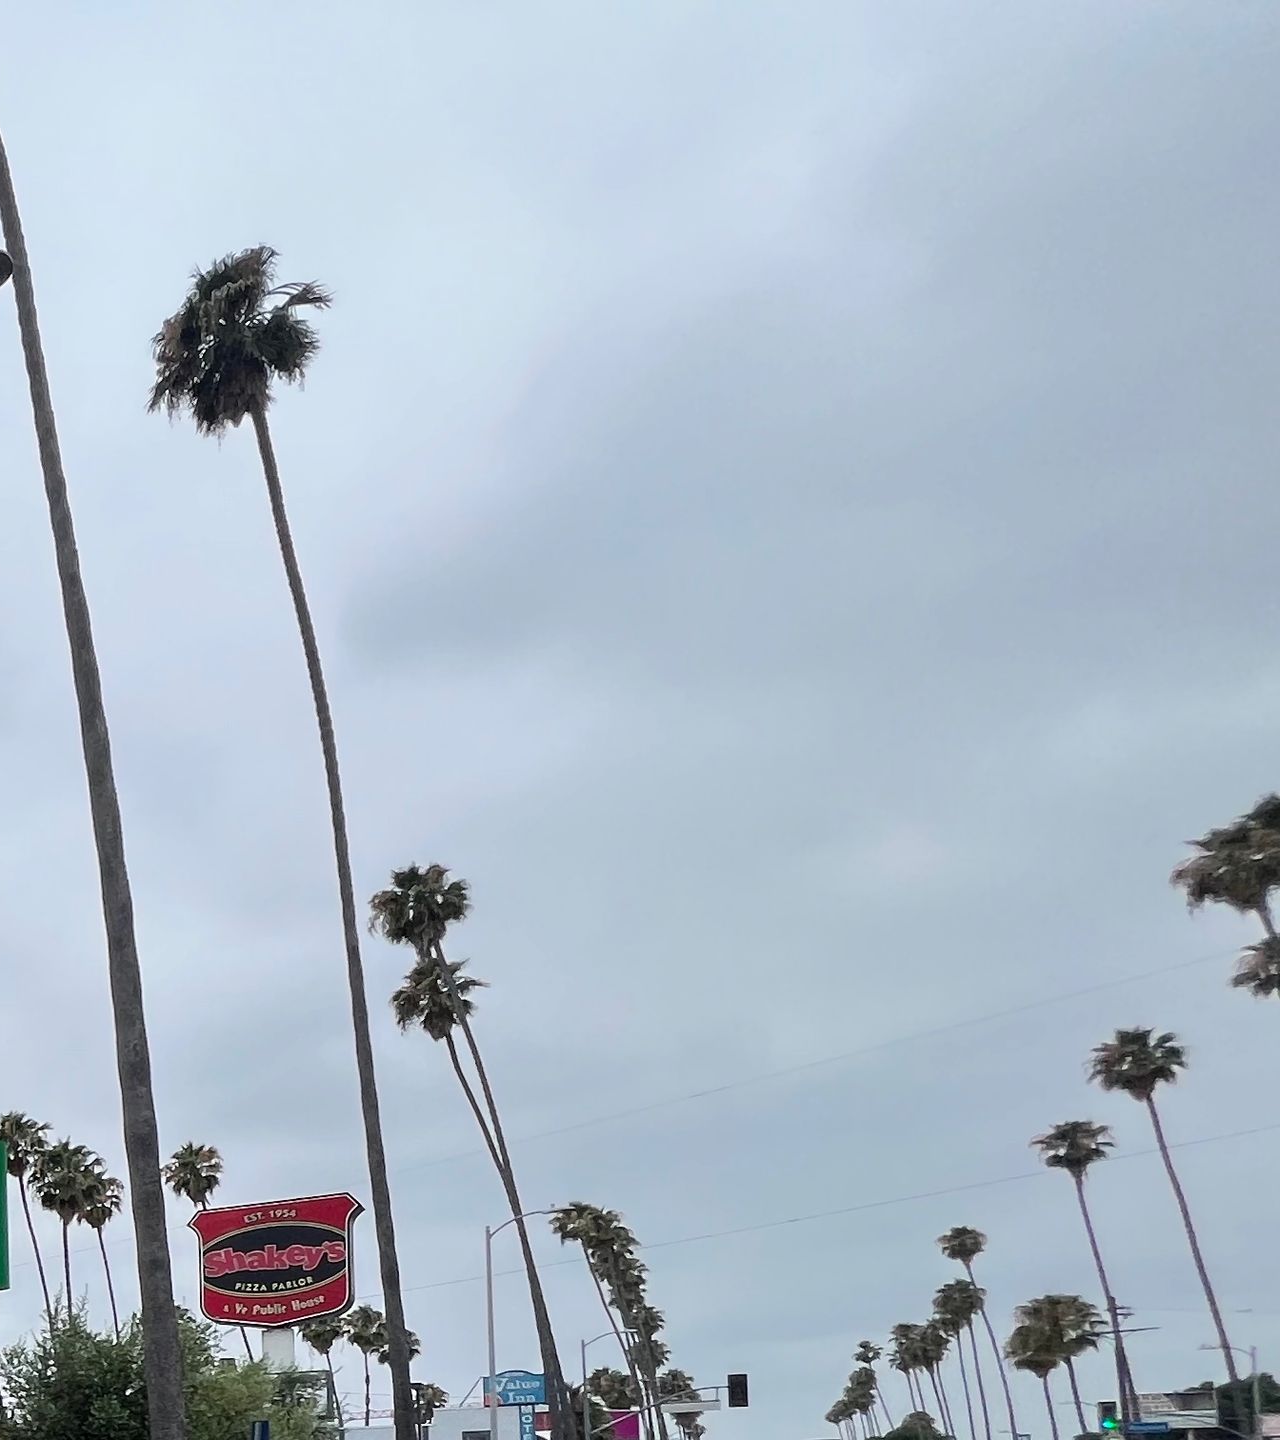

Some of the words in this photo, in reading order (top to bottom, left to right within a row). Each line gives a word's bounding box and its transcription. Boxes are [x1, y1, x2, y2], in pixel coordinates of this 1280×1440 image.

[244, 1212, 265, 1223] EST.
[268, 1209, 297, 1218] 1954
[205, 1241, 346, 1278] Shakey's
[235, 1282, 267, 1291] PIZZA
[272, 1276, 313, 1290] PARLOR
[252, 1304, 287, 1315] Public
[291, 1295, 325, 1311] House
[495, 1378, 540, 1392] Value
[507, 1392, 536, 1403] Inn
